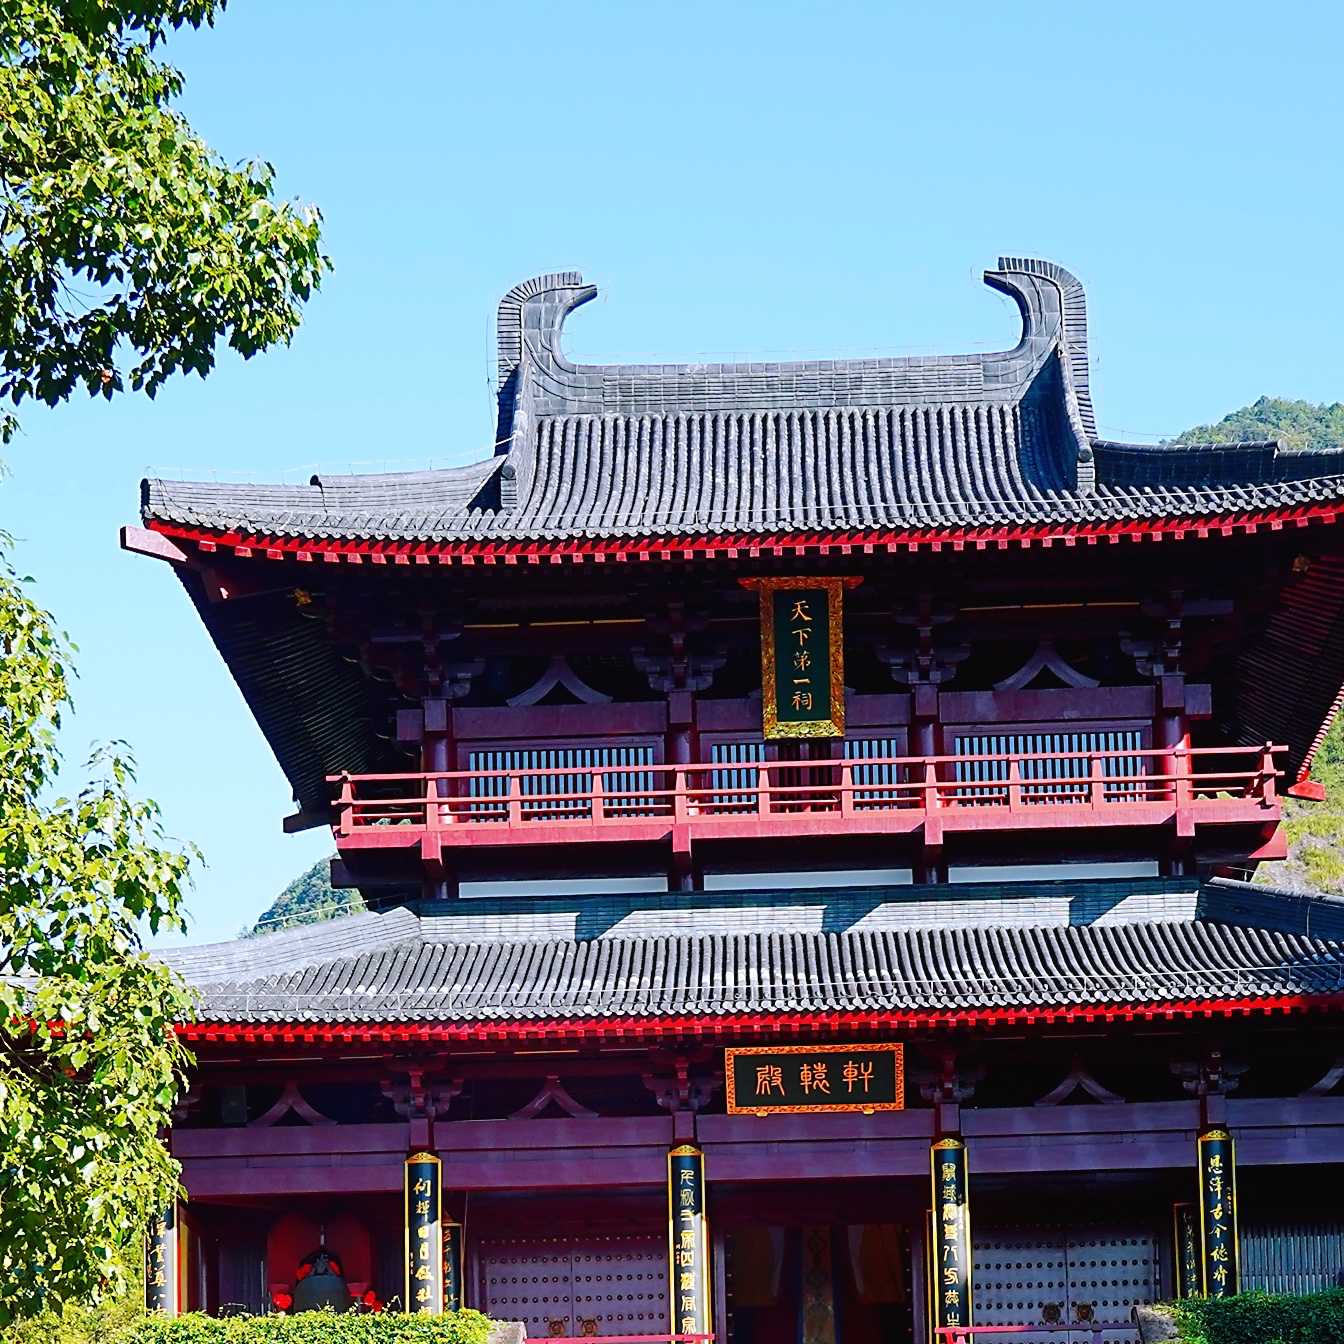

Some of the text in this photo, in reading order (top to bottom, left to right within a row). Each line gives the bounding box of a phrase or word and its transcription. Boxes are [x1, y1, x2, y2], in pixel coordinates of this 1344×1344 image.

[791, 599, 813, 711] 天下第一祠
